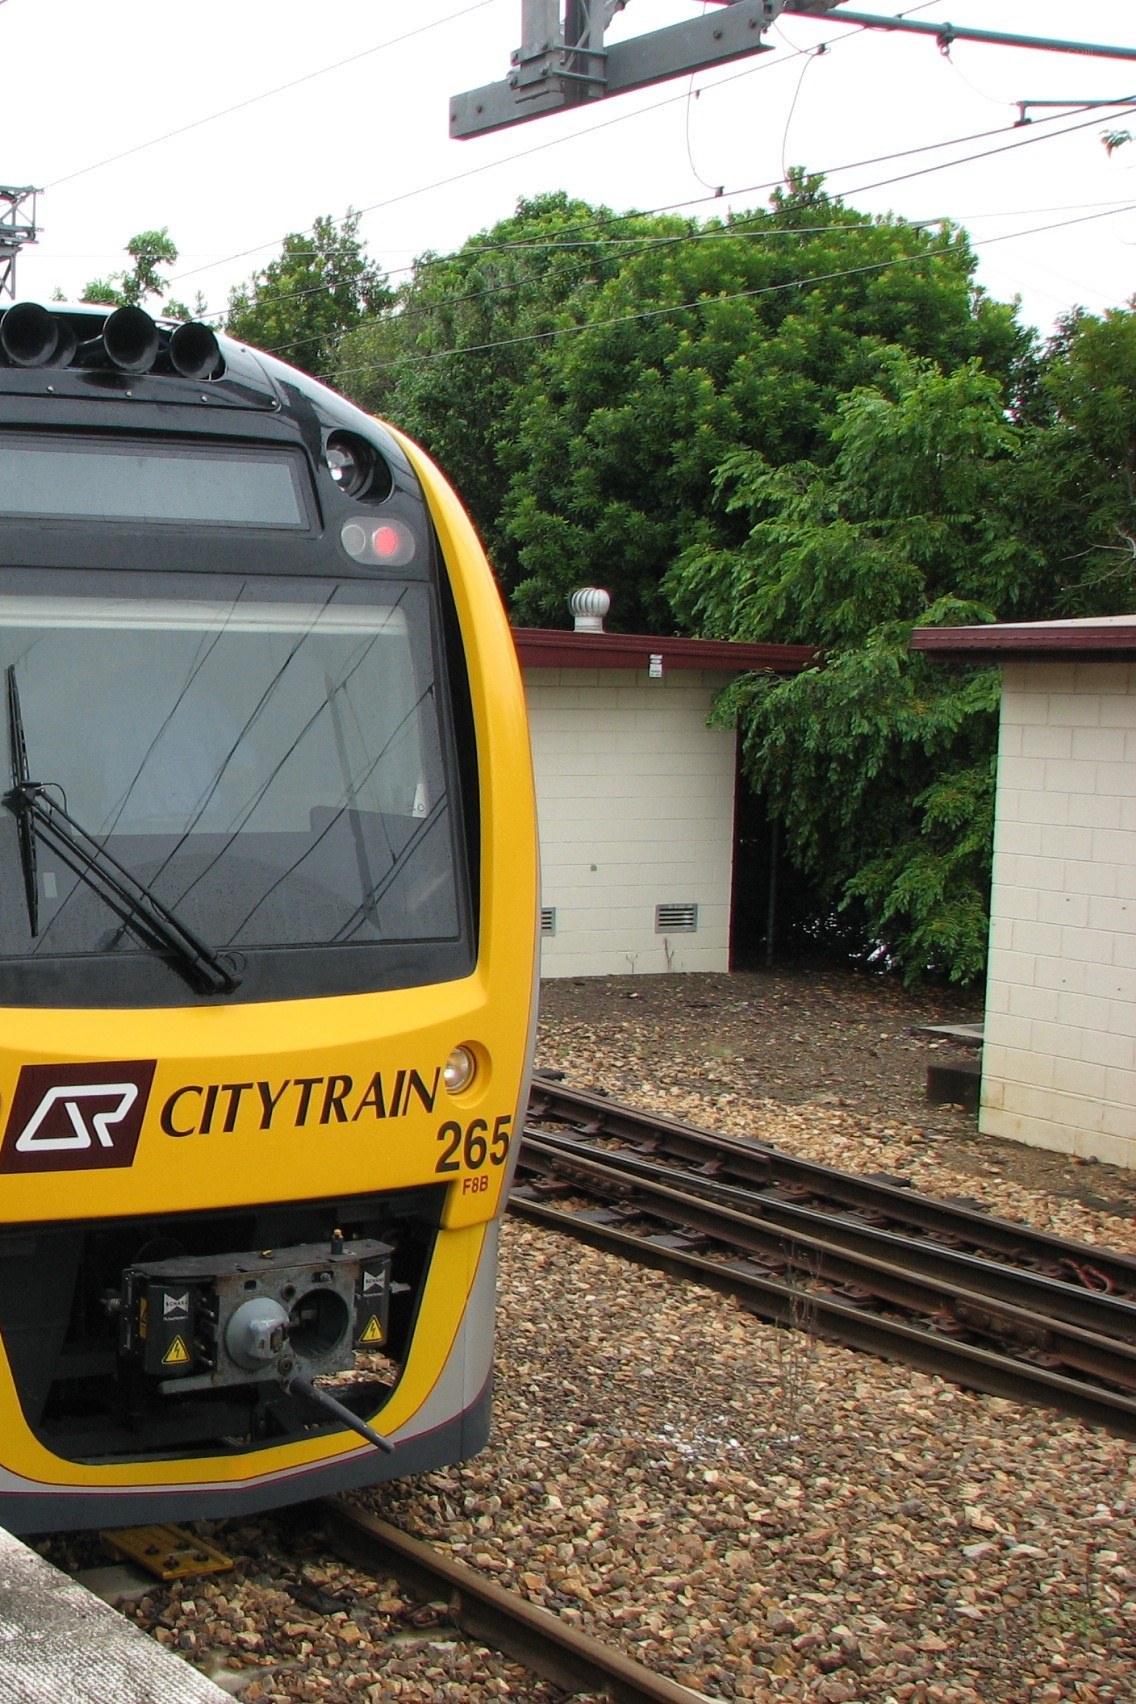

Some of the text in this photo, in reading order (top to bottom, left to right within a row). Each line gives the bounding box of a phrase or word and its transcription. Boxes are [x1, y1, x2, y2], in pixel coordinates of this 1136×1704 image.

[160, 1067, 442, 1138] CITYTRAIN
[435, 1114, 511, 1174] 265
[462, 1175, 489, 1196] F8B
